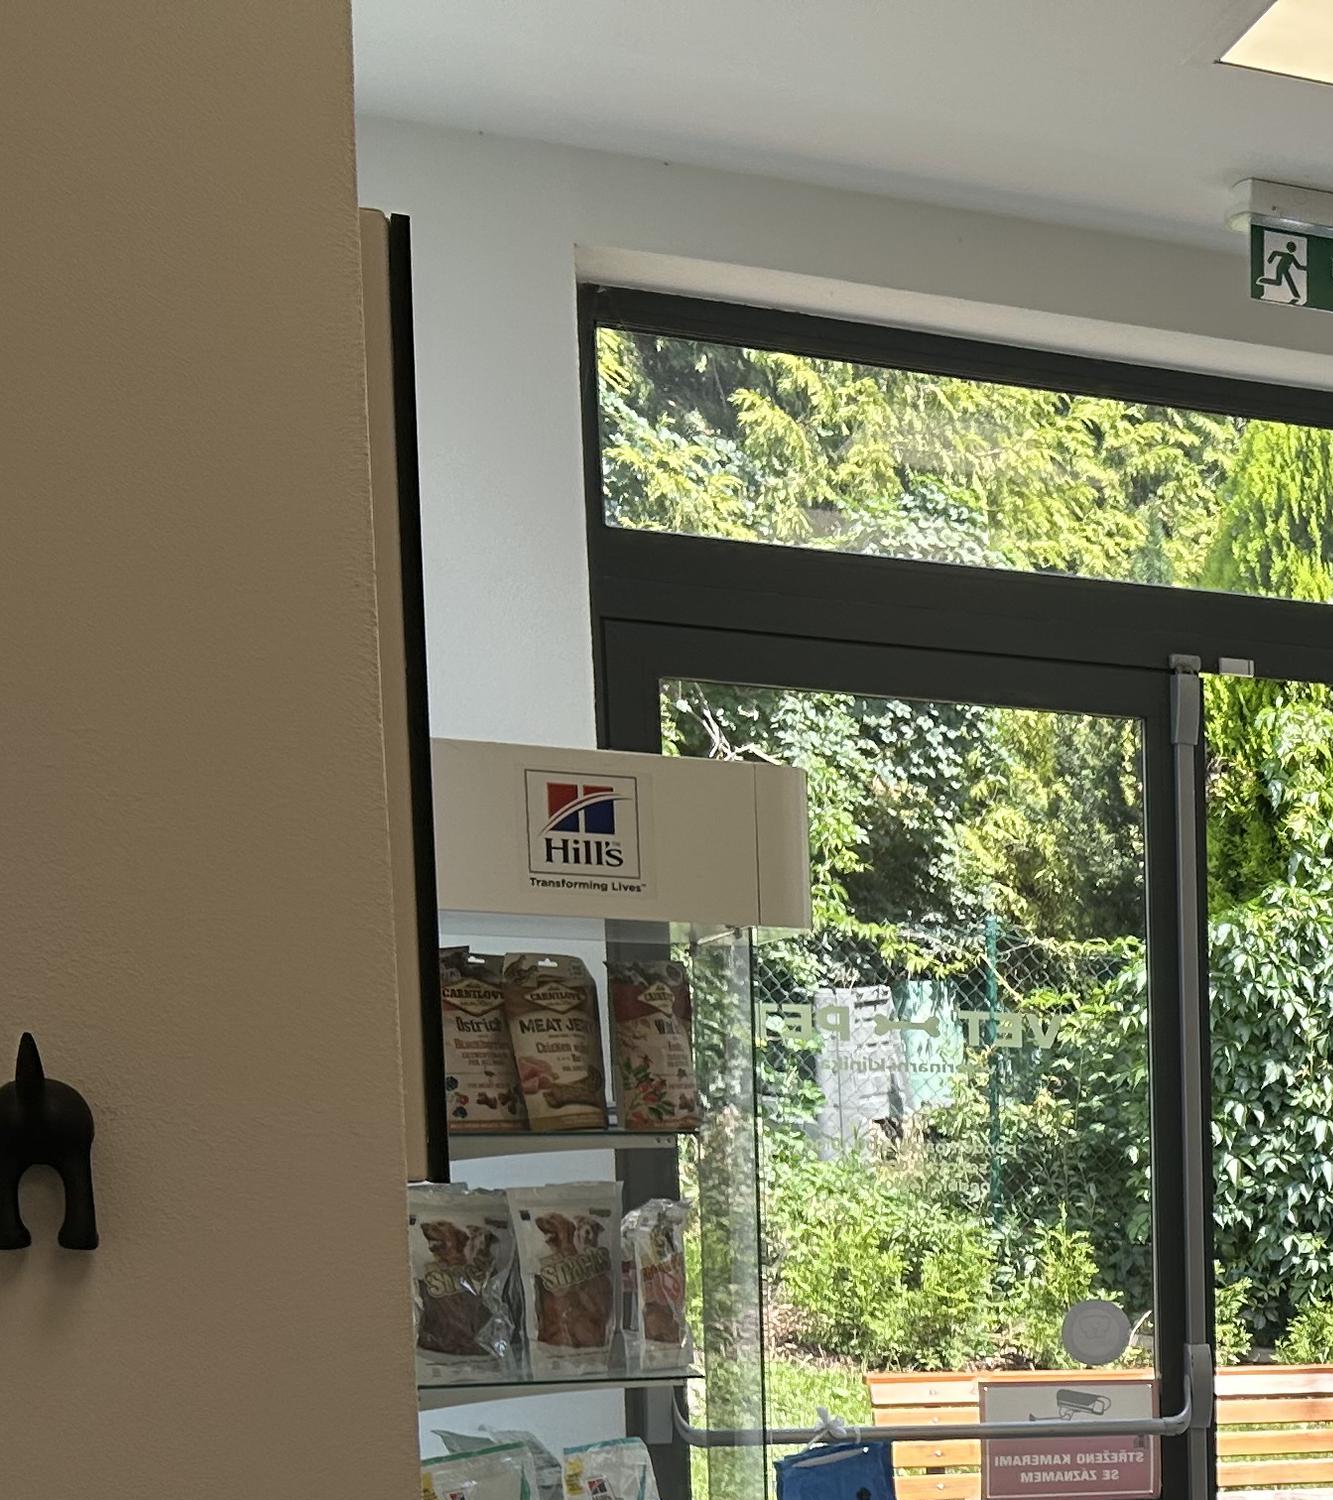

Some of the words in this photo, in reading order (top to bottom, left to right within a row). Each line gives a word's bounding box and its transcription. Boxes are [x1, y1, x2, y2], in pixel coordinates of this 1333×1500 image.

[544, 837, 624, 868] Hill's
[529, 877, 608, 892] Transforming
[611, 881, 642, 893] Lives
[519, 1018, 562, 1034] MEAT
